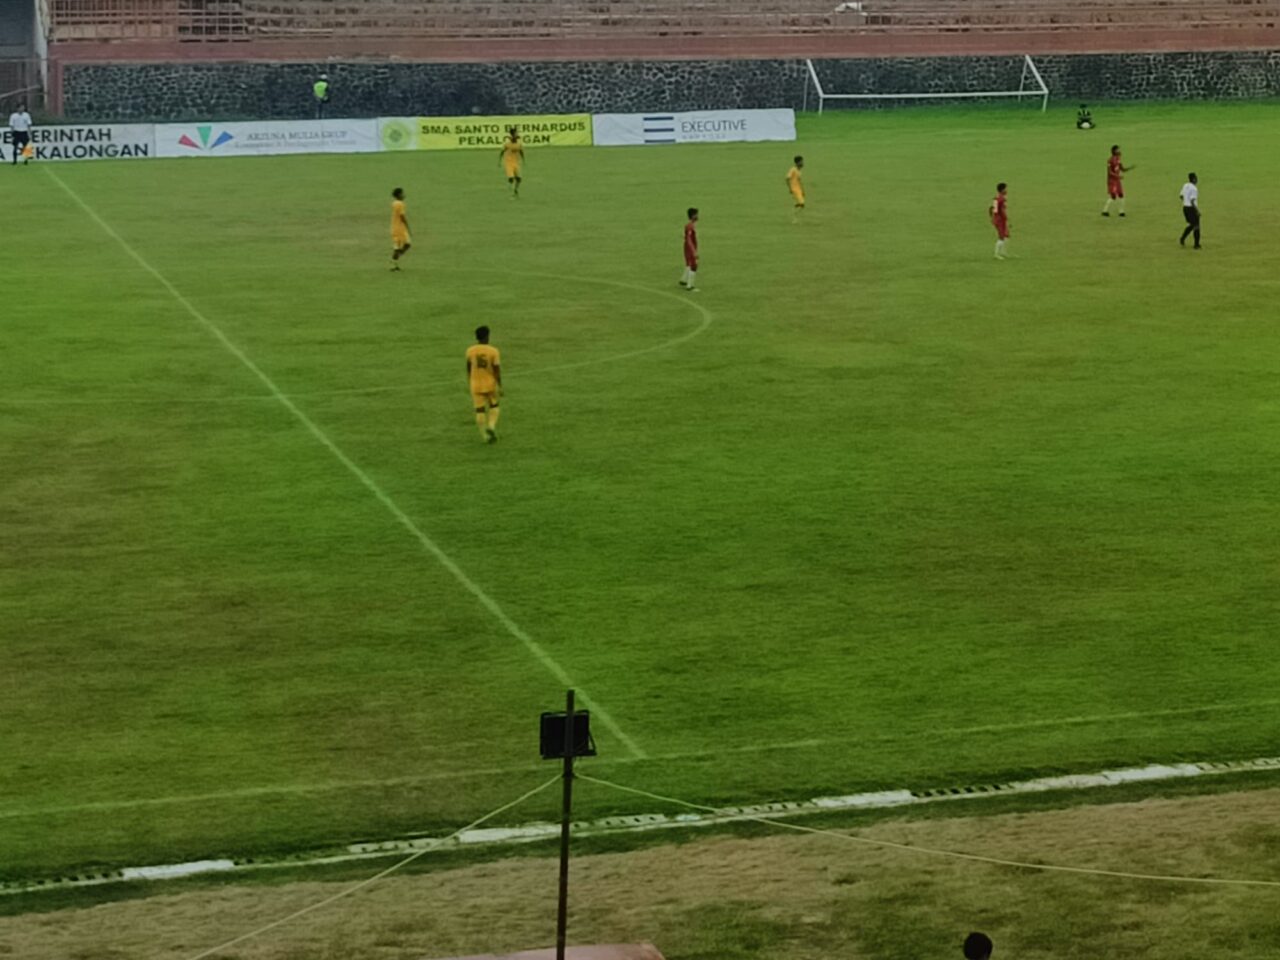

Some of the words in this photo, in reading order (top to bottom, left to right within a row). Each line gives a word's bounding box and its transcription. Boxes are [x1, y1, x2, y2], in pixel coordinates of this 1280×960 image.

[421, 125, 450, 134] SMA
[455, 124, 500, 134] SANTO
[504, 122, 586, 133] BERNARDUS
[681, 119, 747, 133] EXECUTIVE
[0, 128, 111, 144] EERINTAH
[459, 134, 551, 145] PEKALGAN
[15, 143, 148, 159] KALONGAN
